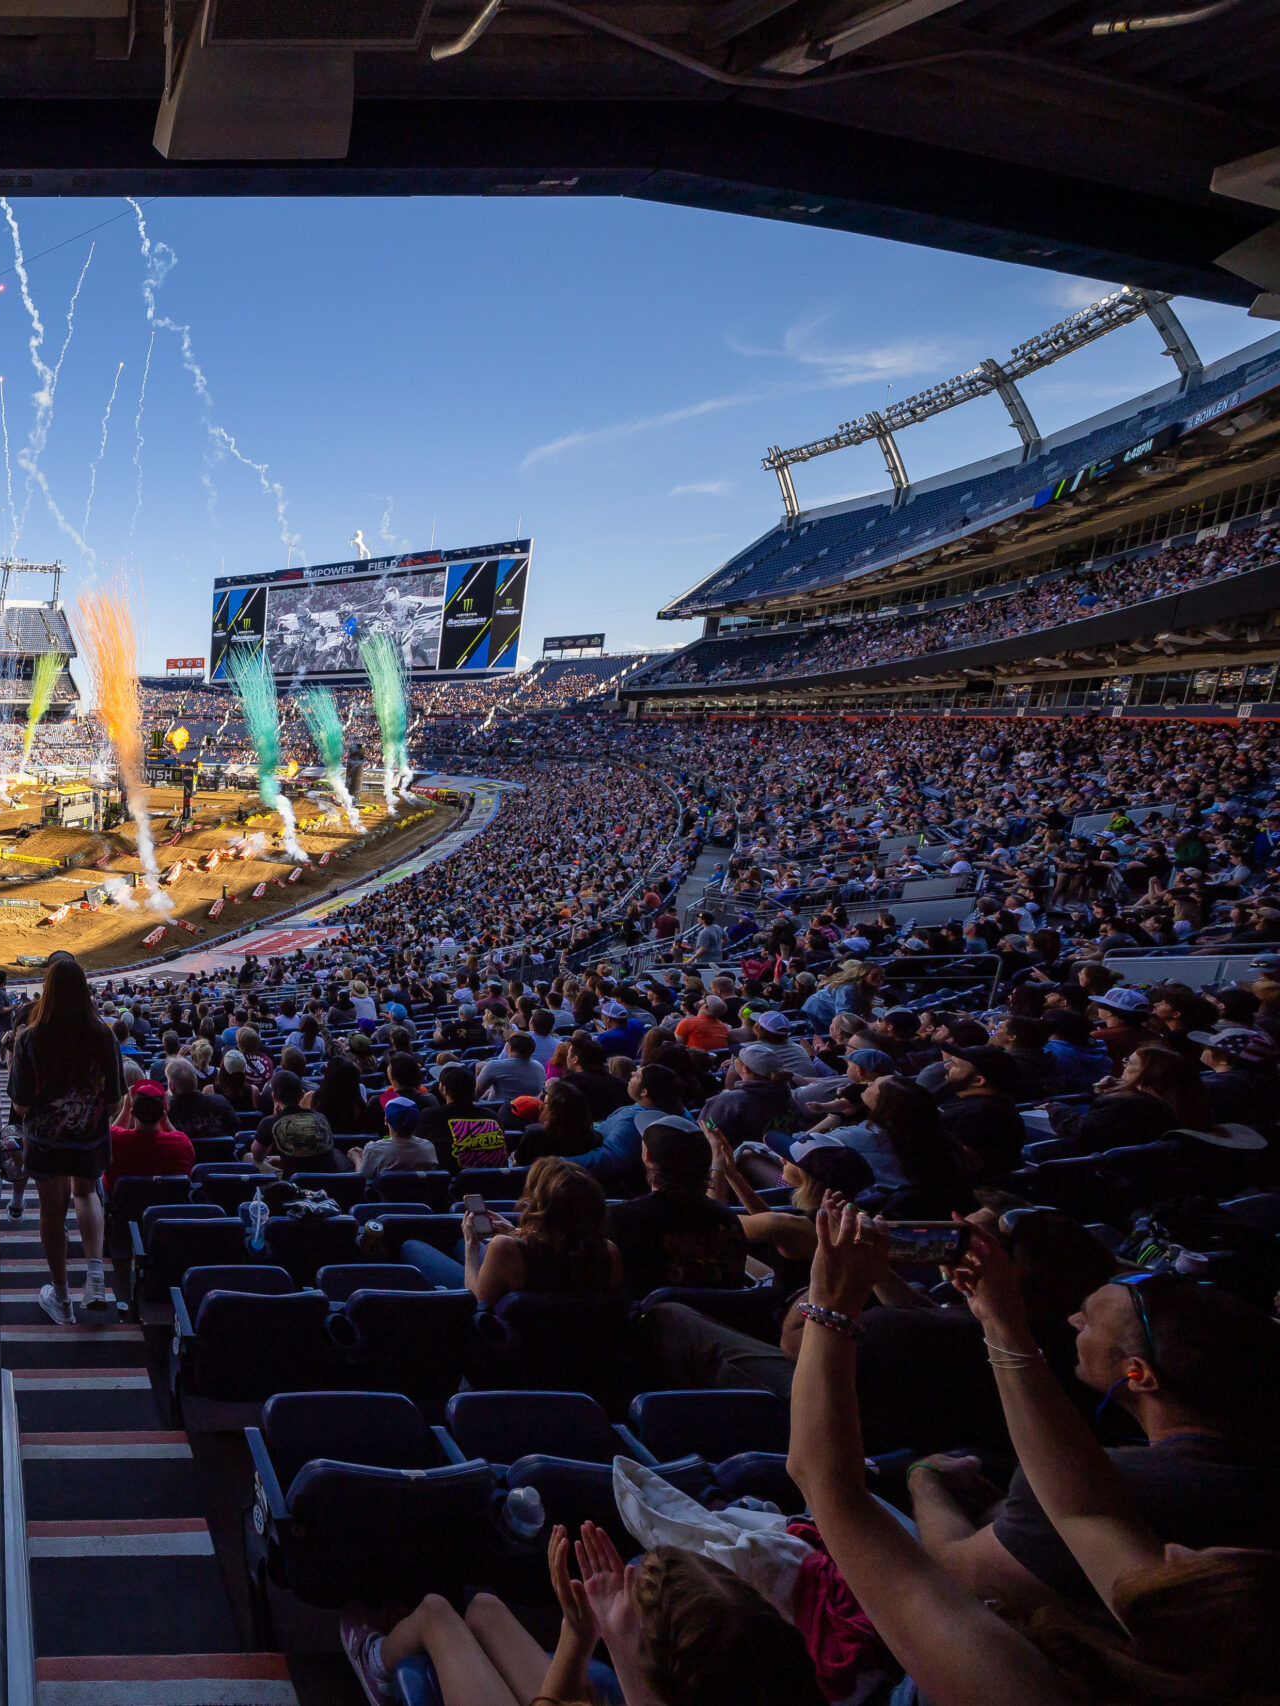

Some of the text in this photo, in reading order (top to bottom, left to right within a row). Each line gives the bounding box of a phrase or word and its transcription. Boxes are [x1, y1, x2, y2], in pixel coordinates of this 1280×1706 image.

[1195, 398, 1229, 427] BOWLEN
[1123, 438, 1154, 463] 4:48PM
[303, 559, 398, 579] EMPOWER FIELD
